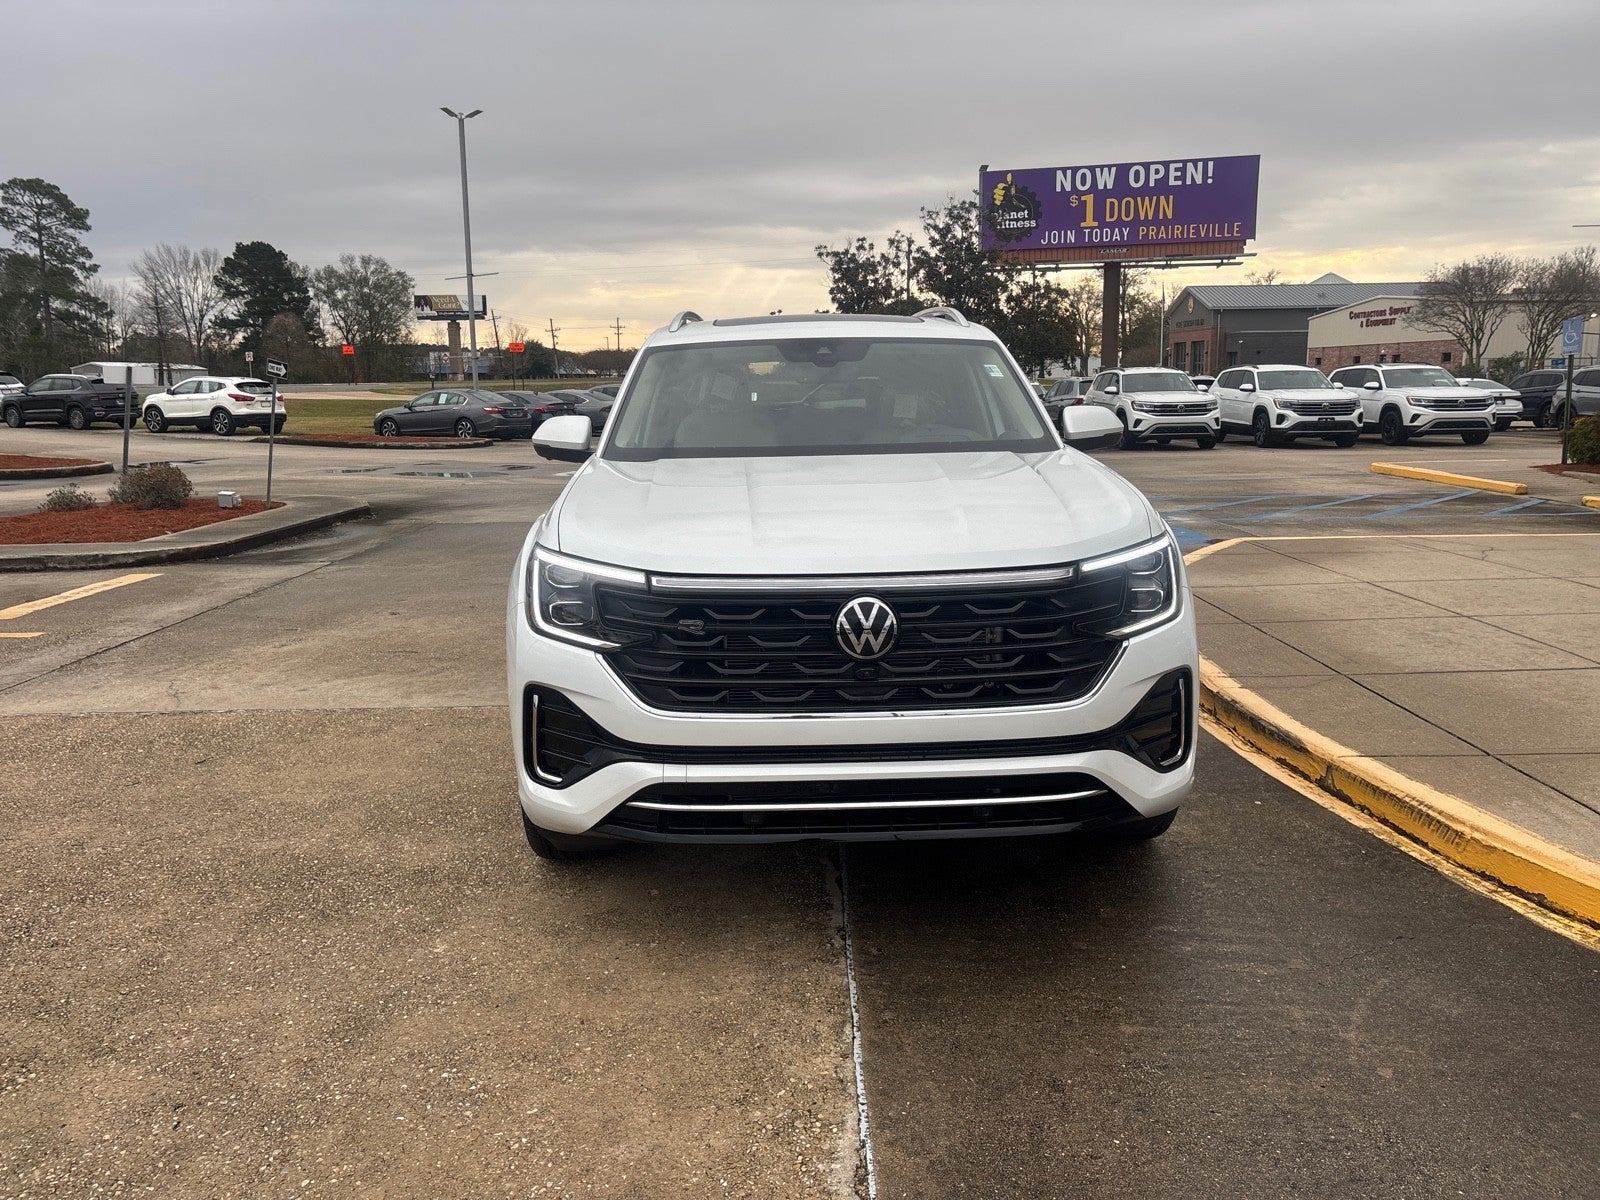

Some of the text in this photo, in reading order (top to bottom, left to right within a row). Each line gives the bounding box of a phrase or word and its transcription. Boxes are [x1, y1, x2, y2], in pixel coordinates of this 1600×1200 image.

[1055, 161, 1214, 192] NOW OPEN!
[1069, 193, 1174, 228] $1 DOWN
[1040, 222, 1242, 245] JOIN TODAY PRAIRIEVILLE
